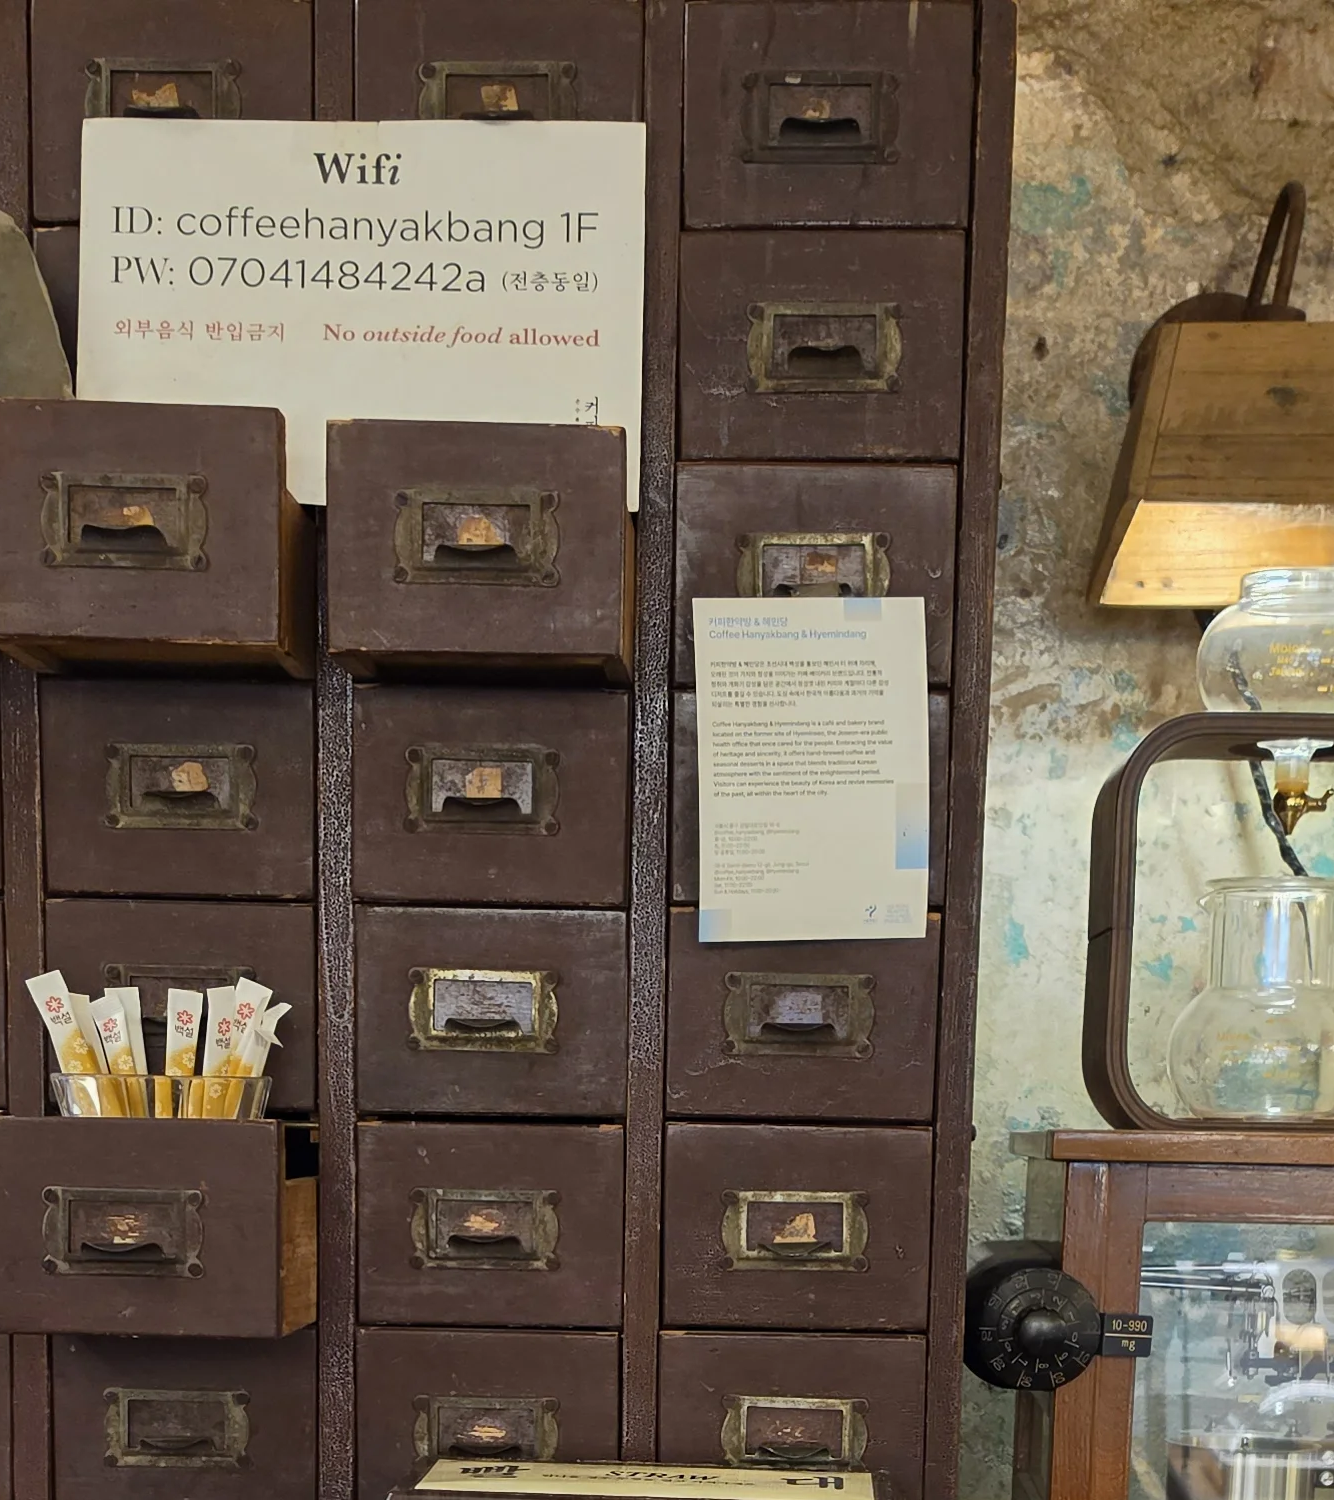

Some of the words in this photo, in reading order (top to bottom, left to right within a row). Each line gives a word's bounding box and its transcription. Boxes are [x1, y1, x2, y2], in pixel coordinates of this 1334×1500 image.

[313, 152, 403, 186] Wifi
[111, 206, 163, 237] ID:
[177, 206, 545, 249] coffeehanyakbang
[561, 212, 598, 243] 1F
[111, 257, 174, 287] PW:
[188, 257, 486, 293] 07041484242a
[501, 271, 599, 293] (전층동일)
[114, 318, 194, 341] 외부음식
[206, 322, 286, 343] 반입금지
[323, 324, 356, 342] No
[363, 325, 447, 345] outside
[447, 326, 502, 348] food
[508, 329, 599, 347] allowed
[709, 630, 740, 639] Coffee
[742, 630, 799, 641] Hanyakbang
[801, 630, 808, 639] &
[810, 629, 867, 641] Hyemindang
[50, 1011, 73, 1025] 백설
[103, 1031, 122, 1044] 백설
[174, 1025, 194, 1039] 백설
[215, 1037, 231, 1050] 백설
[1112, 1320, 1147, 1332] 10-990
[1122, 1339, 1136, 1351] mg
[605, 1470, 719, 1482] STRAW
